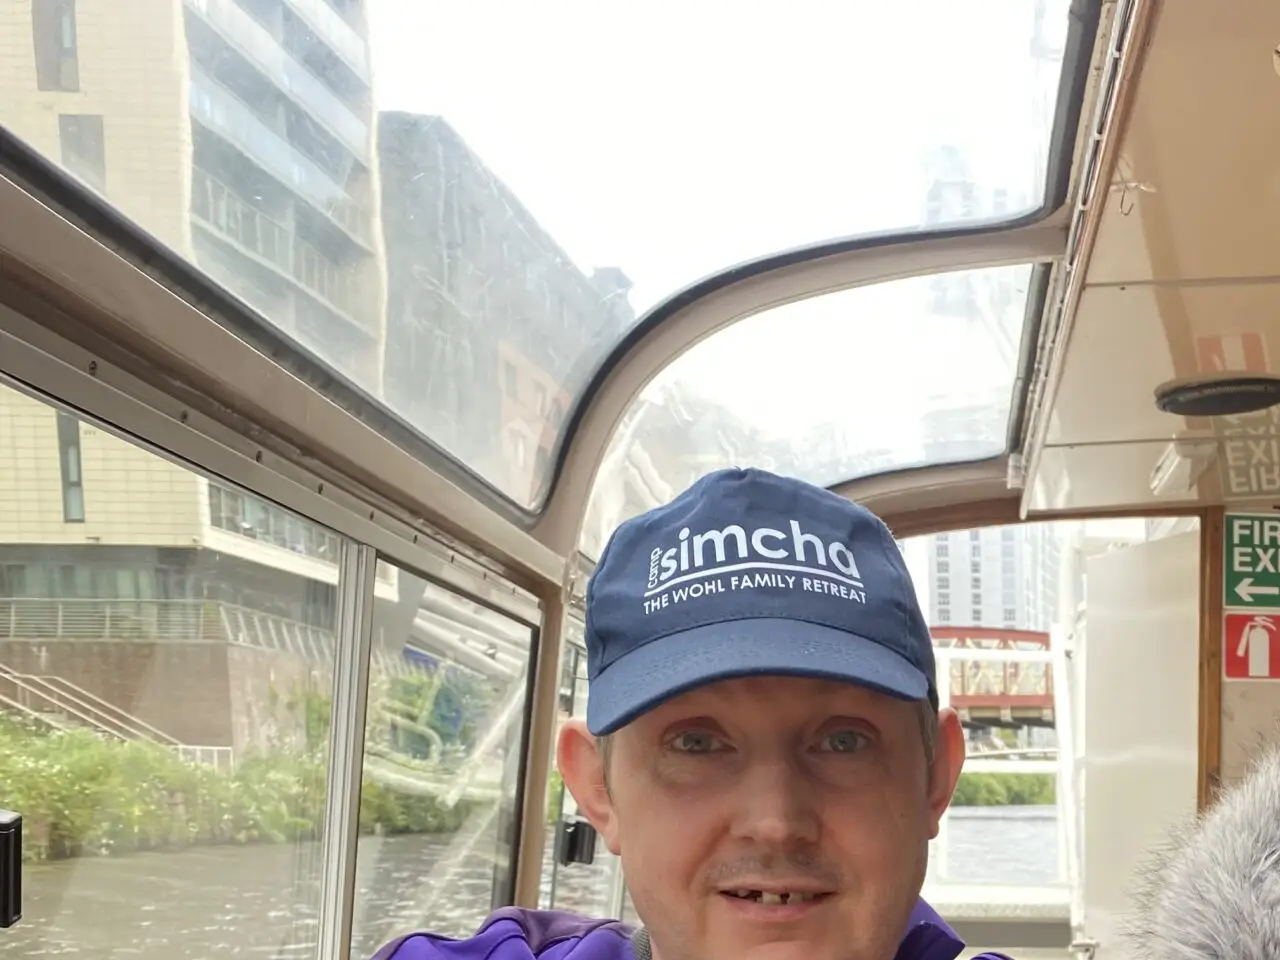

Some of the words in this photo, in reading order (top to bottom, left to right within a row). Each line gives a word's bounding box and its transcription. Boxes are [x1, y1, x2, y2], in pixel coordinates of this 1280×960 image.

[647, 547, 663, 588] camp
[659, 520, 861, 581] simcha
[643, 594, 669, 615] THE
[672, 580, 726, 603] WOHL
[731, 573, 797, 591] FAMILY
[802, 577, 867, 604] RETREAT
